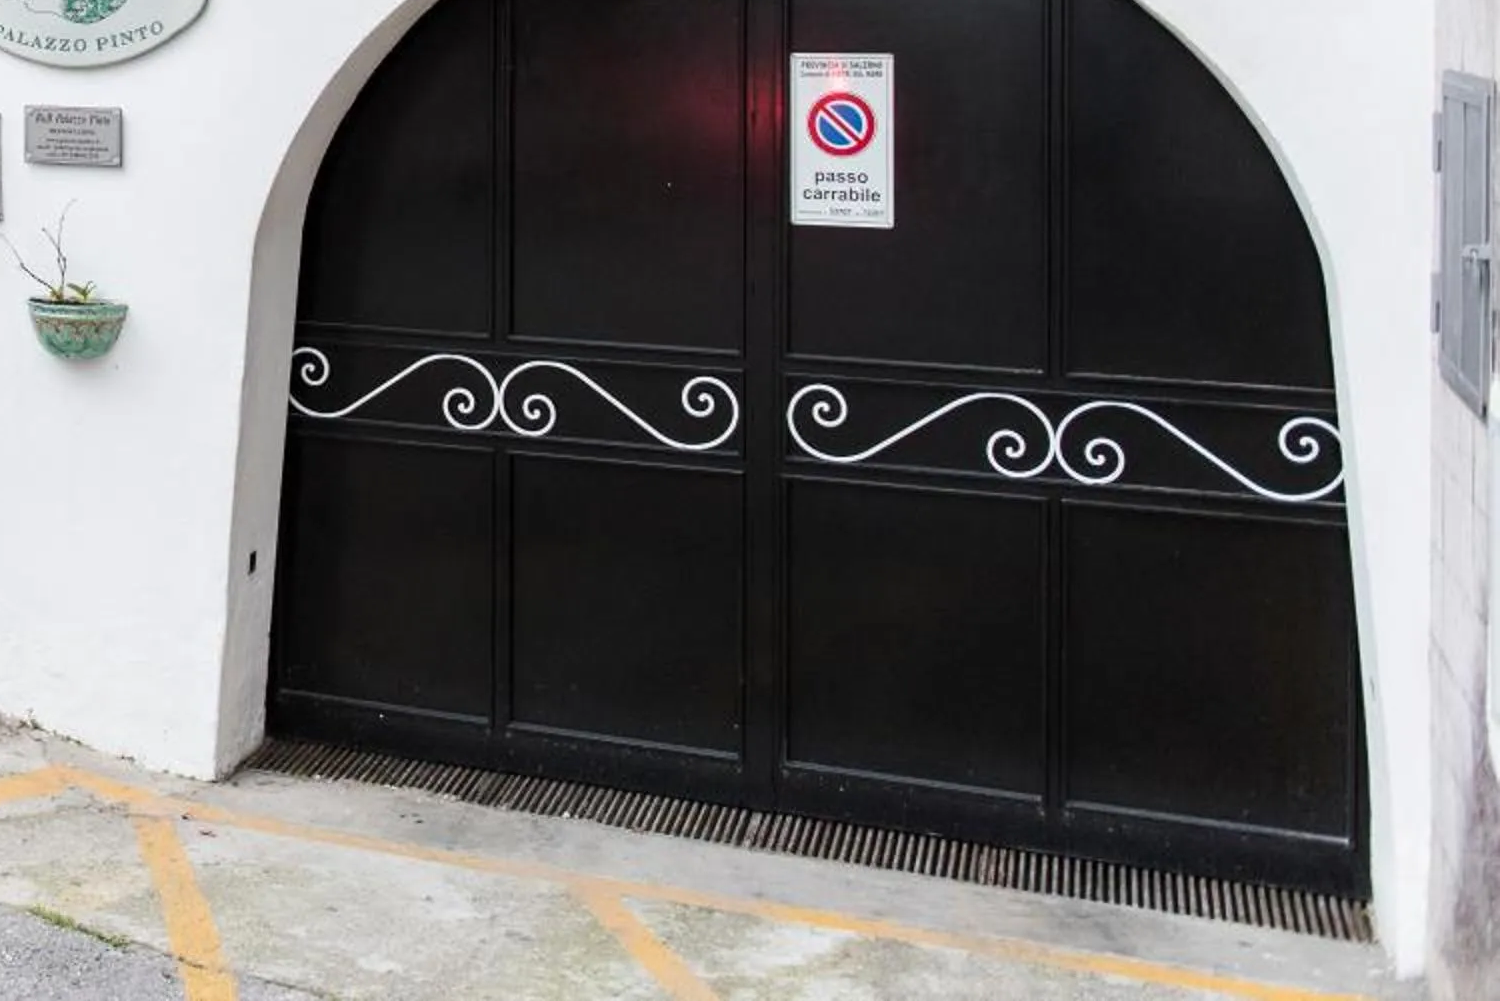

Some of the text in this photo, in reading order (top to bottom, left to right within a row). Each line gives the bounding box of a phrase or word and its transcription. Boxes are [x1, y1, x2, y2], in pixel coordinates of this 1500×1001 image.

[96, 20, 165, 51] PINTO
[815, 171, 869, 185] passo
[803, 187, 882, 203] carrabile
